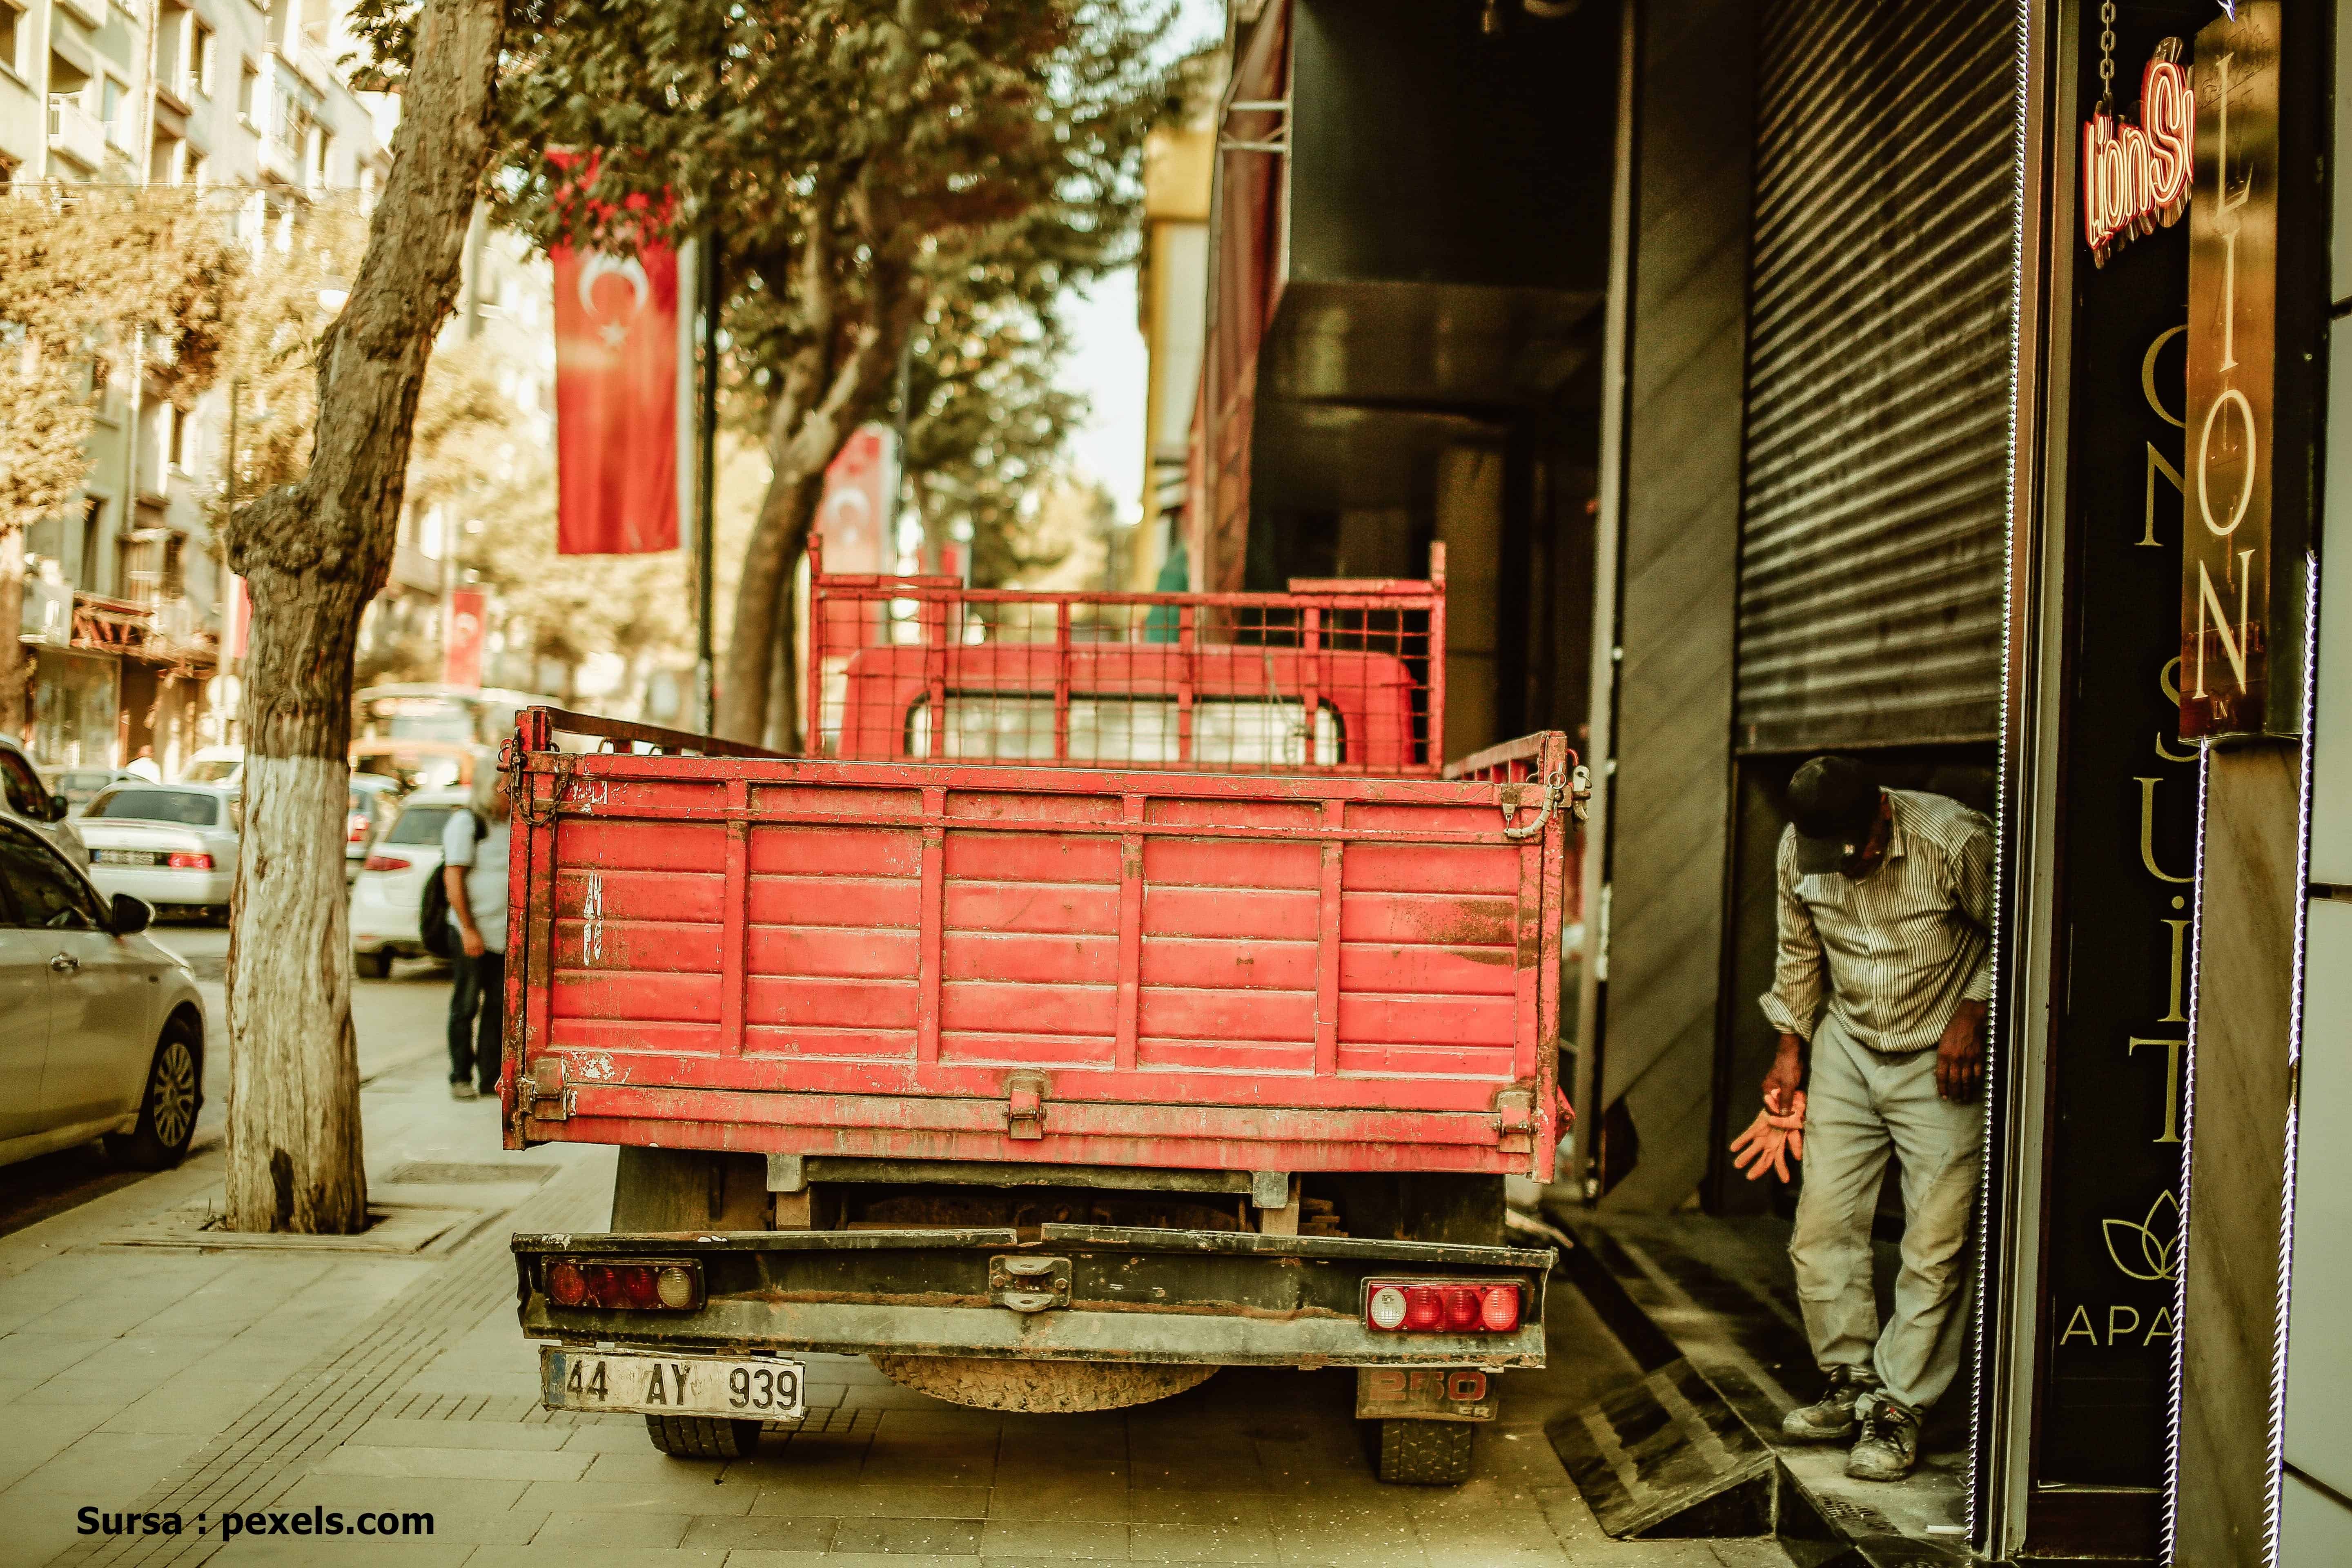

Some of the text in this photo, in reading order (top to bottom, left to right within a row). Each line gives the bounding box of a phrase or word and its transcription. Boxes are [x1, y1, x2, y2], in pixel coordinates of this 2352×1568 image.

[2191, 51, 2257, 699] LION
[566, 1359, 797, 1411] 44 AY 939
